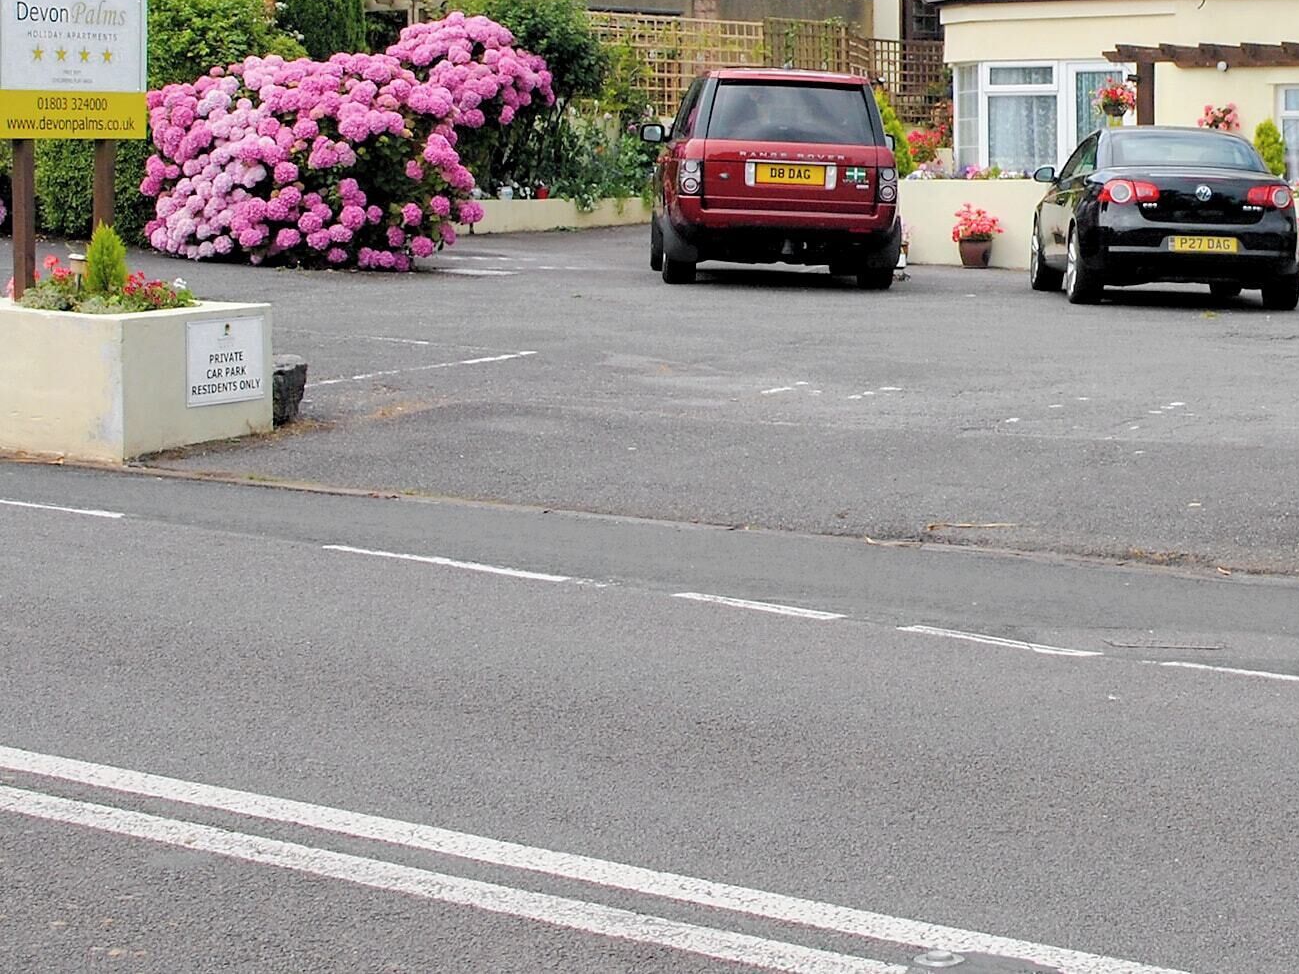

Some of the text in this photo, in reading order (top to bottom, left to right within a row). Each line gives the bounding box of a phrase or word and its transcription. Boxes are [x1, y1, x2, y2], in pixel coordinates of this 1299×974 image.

[17, 0, 126, 26] Devon Palms
[28, 30, 118, 41] HOLIDAY APARTMENTS
[37, 97, 107, 112] 01803 324000
[7, 115, 135, 132] www.devonpalms.co.uk
[739, 150, 788, 158] RANGE
[770, 167, 811, 180] D8 DAG
[1180, 237, 1231, 250] P27 DAG
[209, 351, 244, 364] PRIVATE
[206, 365, 247, 380] CAR PARK
[191, 378, 261, 396] RESIDENTS ONLY
